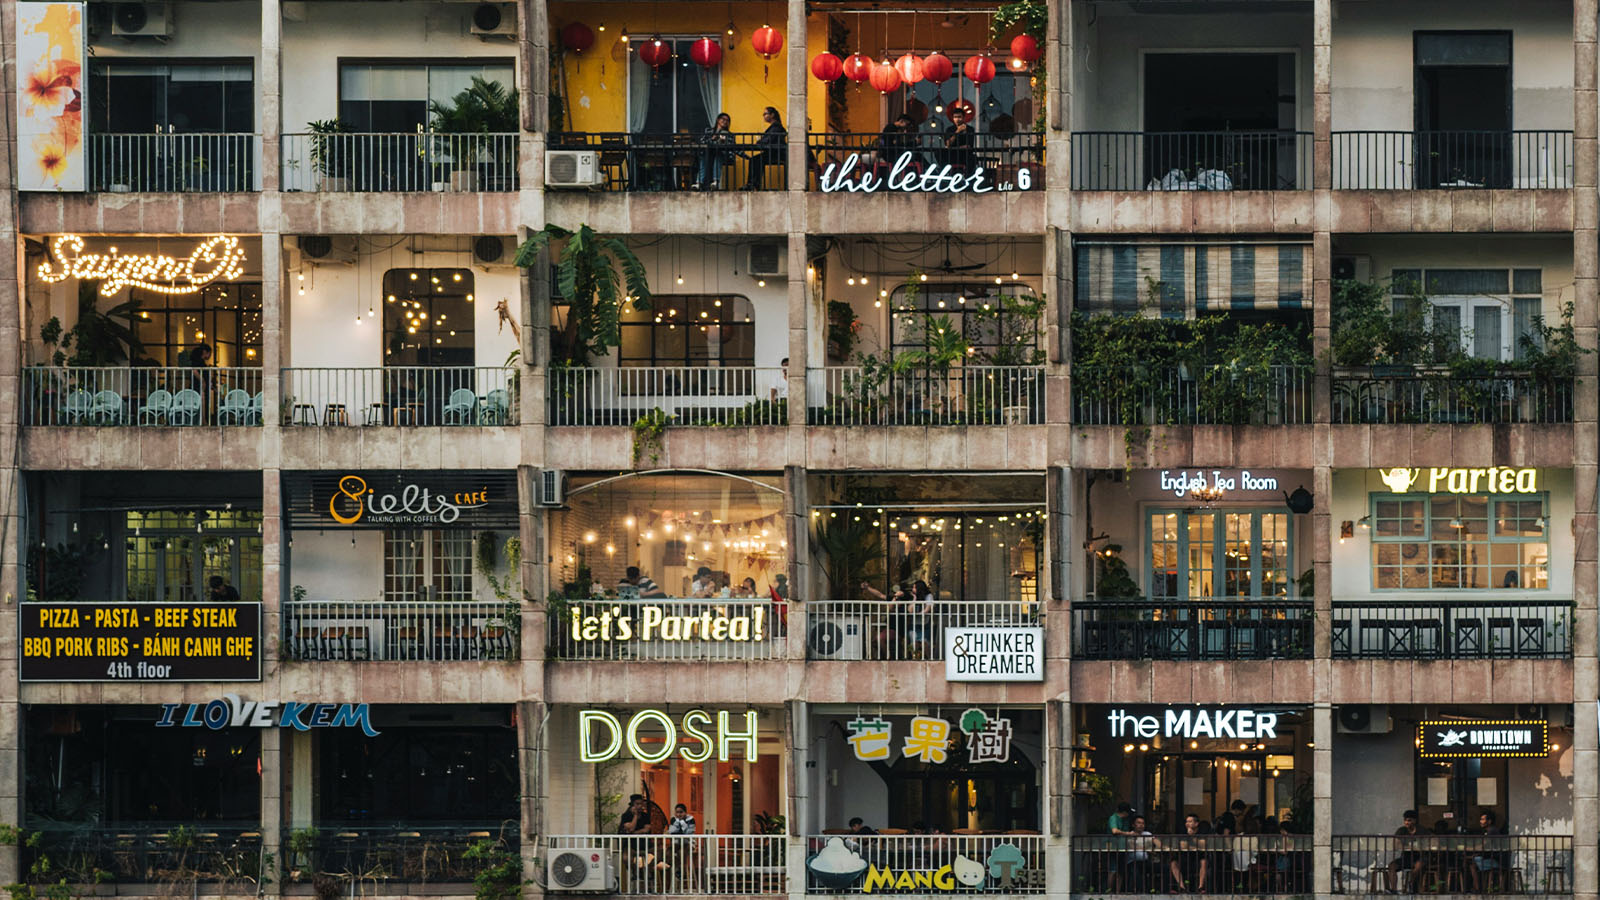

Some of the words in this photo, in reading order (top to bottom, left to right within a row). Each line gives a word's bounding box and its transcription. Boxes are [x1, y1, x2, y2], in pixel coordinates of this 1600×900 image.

[820, 153, 882, 192] the
[888, 151, 993, 192] letter
[1018, 168, 1031, 190] 6
[37, 234, 198, 297] Saigon
[455, 486, 488, 505] CAFÉ
[1161, 470, 1207, 497] English
[1212, 470, 1235, 490] Tea
[1241, 470, 1277, 490] Room
[367, 515, 394, 523] TALKING
[395, 515, 412, 523] WITH
[413, 515, 438, 523] COFFEE
[39, 608, 80, 628] PIZZA
[95, 608, 139, 628] PASTA
[154, 608, 189, 628] BEEF
[192, 608, 237, 628] STEAK
[571, 606, 632, 641] let's
[641, 606, 764, 641] Partea!
[23, 637, 52, 659] BBQ
[55, 637, 93, 657] PORK
[97, 637, 129, 657] RIBS
[143, 632, 180, 657] BÁNH
[184, 637, 222, 657] CANH
[225, 637, 253, 661] GHẸ
[963, 633, 1035, 653] THINKER
[106, 662, 132, 678] 4th
[137, 662, 172, 678] floor
[957, 654, 1035, 674] DREAMER
[155, 703, 181, 727] I
[182, 693, 279, 730] LOVE
[279, 701, 382, 738] KEM
[1107, 709, 1160, 738] the
[1165, 709, 1277, 739] MAKER
[579, 709, 758, 764] DOSH
[847, 709, 1013, 764] 芒果樹
[1470, 730, 1532, 745] DOWNTOWN
